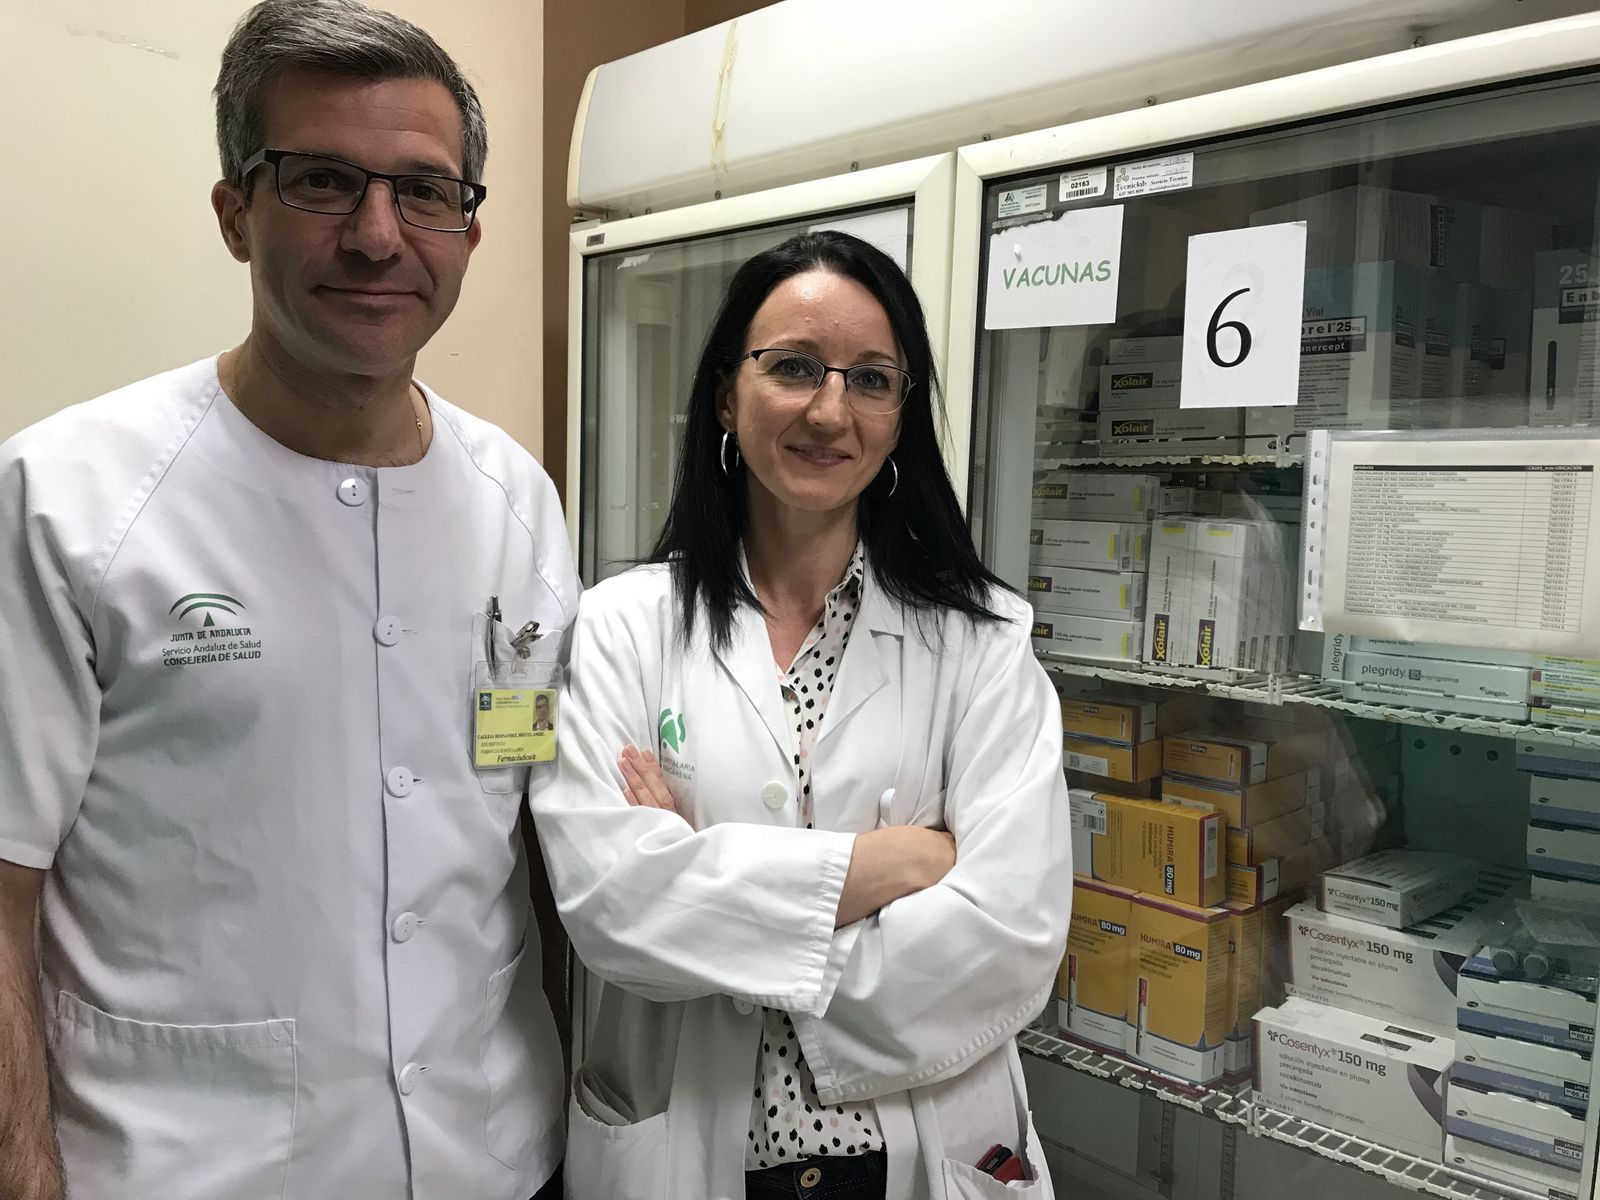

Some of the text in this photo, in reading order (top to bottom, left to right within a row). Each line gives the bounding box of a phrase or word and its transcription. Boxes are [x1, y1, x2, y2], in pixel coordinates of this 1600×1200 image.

[1003, 260, 1112, 290] VACUNAS
[1560, 264, 1588, 284] 25
[1206, 287, 1252, 368] 6
[1337, 321, 1352, 332] 25
[170, 632, 194, 642] JUNTA
[197, 631, 207, 640] DE
[162, 640, 261, 656] Servicio Andaluz de Salud
[1331, 633, 1345, 672] plegridy
[164, 651, 261, 667] CONSEJERÍA DE SALUD
[1361, 664, 1405, 678] plegridy
[1166, 867, 1174, 880] 80
[1166, 881, 1173, 894] mg
[1370, 898, 1386, 907] 150
[1386, 902, 1399, 911] mg
[1112, 925, 1125, 935] mg
[1140, 934, 1201, 960] HUMIRA 80 mg
[1366, 941, 1389, 956] 150
[1393, 950, 1414, 964] mg
[1338, 1050, 1362, 1066] 150
[1366, 1061, 1386, 1076] mg
